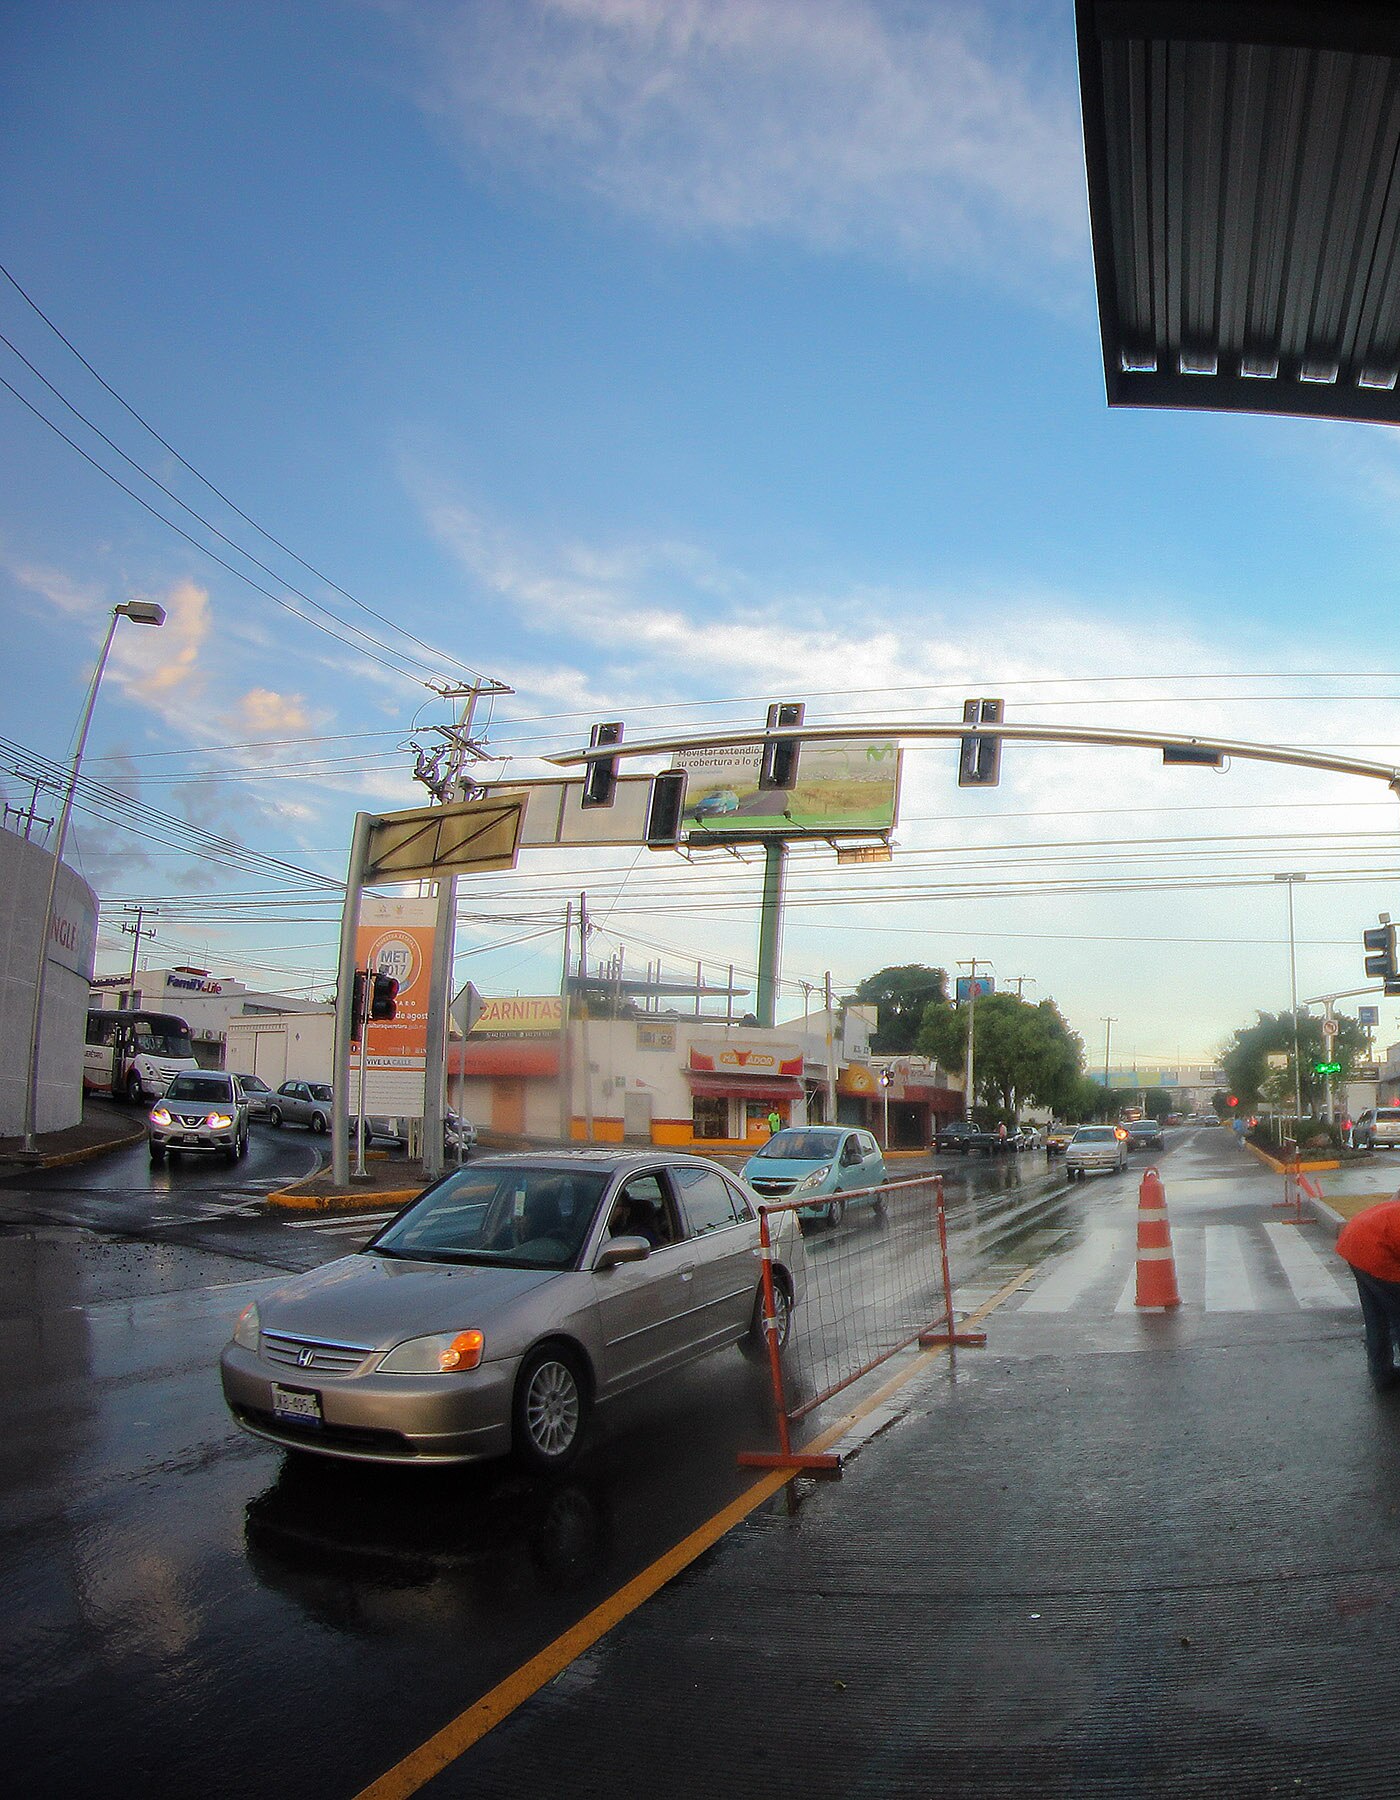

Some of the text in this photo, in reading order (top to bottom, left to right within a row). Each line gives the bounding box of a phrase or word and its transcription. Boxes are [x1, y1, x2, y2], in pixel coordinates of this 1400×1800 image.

[678, 746, 761, 757] Movistar extendió
[676, 760, 687, 768] su
[689, 758, 732, 767] cobertura
[743, 757, 751, 765] lo
[380, 950, 409, 963] MET
[383, 964, 406, 976] 017
[395, 1011, 405, 1019] de
[383, 1058, 391, 1066] LA
